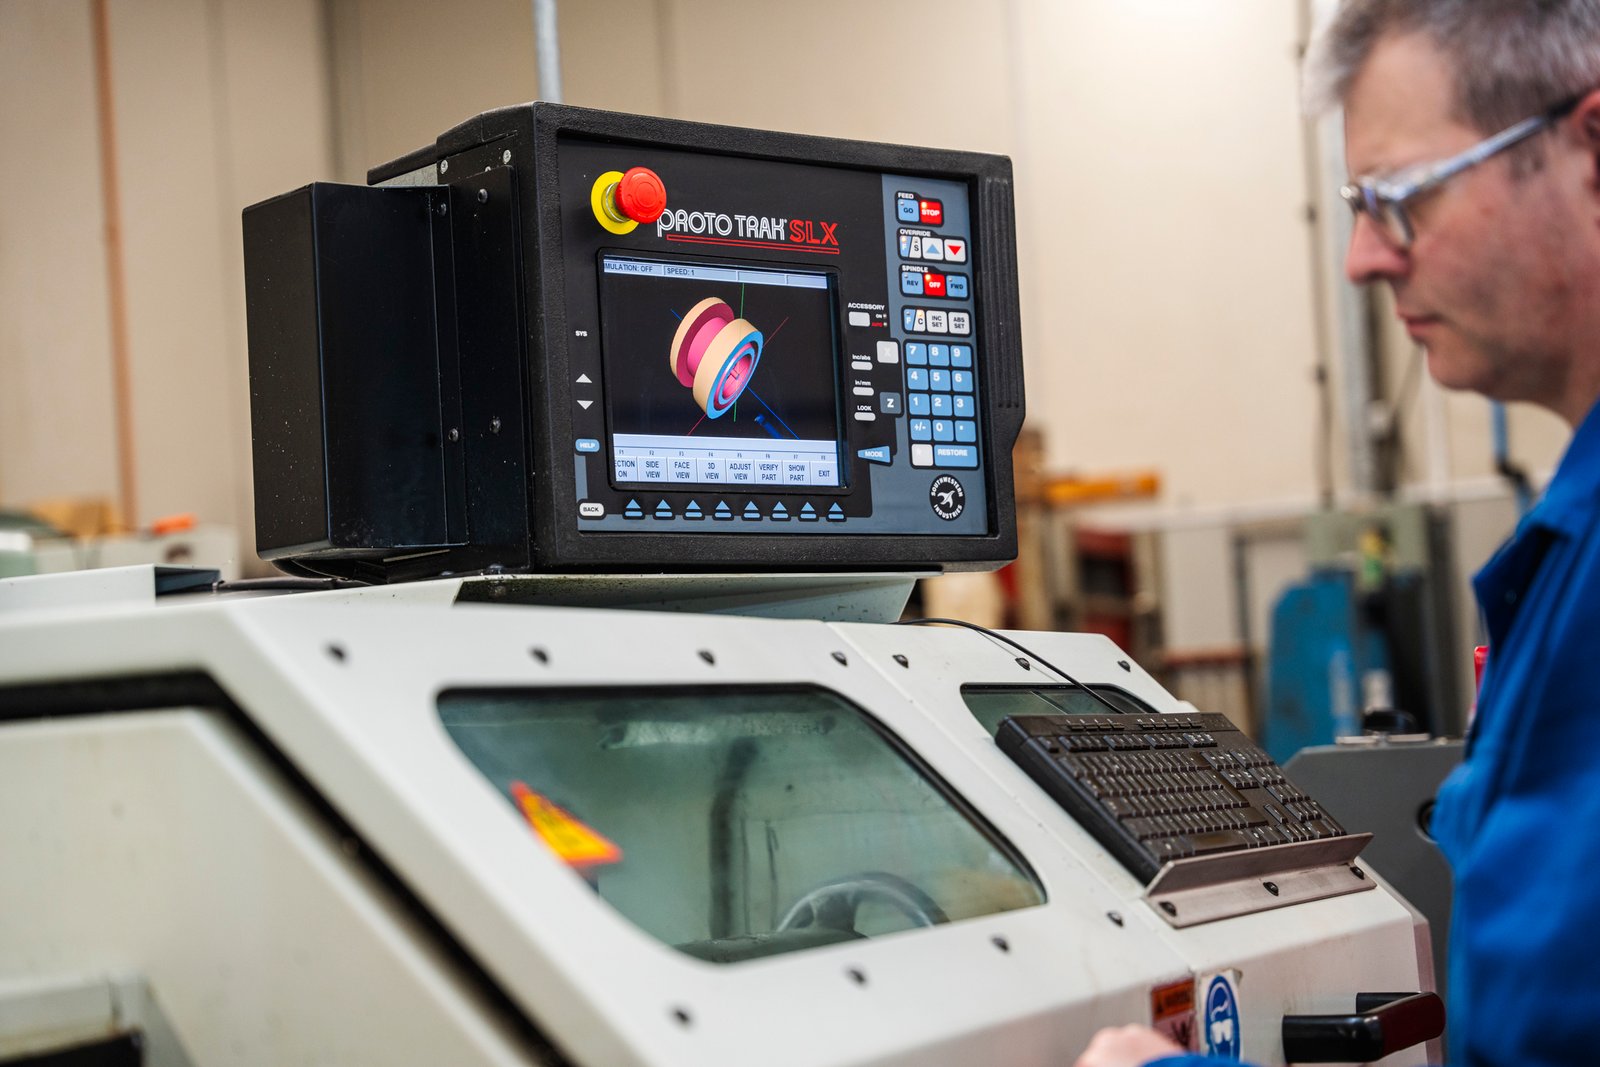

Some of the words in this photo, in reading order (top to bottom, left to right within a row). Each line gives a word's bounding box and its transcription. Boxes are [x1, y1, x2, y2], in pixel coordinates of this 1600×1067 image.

[921, 209, 940, 217] STOP
[657, 208, 733, 238] PROTO
[789, 219, 839, 246] SLX
[899, 229, 931, 237] OVERRIDE
[913, 244, 920, 252] S
[640, 265, 653, 273] OFF
[667, 267, 690, 276] SPEED:
[901, 265, 929, 273] SPINDLE
[847, 302, 886, 310] ACCESSORY
[905, 316, 912, 325] F
[917, 317, 924, 325] C
[909, 345, 917, 355] 7
[931, 346, 939, 356] 8
[953, 348, 961, 357] 9
[910, 370, 918, 380] 4
[933, 371, 940, 381] 5
[954, 373, 962, 383] 6
[886, 398, 895, 408] Z
[912, 397, 919, 406] 1
[934, 397, 942, 407] 2
[956, 398, 964, 408] 3
[935, 422, 944, 432] 0
[864, 450, 884, 458] MODE
[937, 448, 968, 457] RESTORE
[707, 462, 716, 470] 3D
[788, 464, 805, 472] SHOW
[618, 470, 628, 478] ON
[704, 472, 719, 480] VIEW
[930, 476, 964, 498] SOUTHWESTERN
[933, 504, 962, 519] INDUSTRIES
